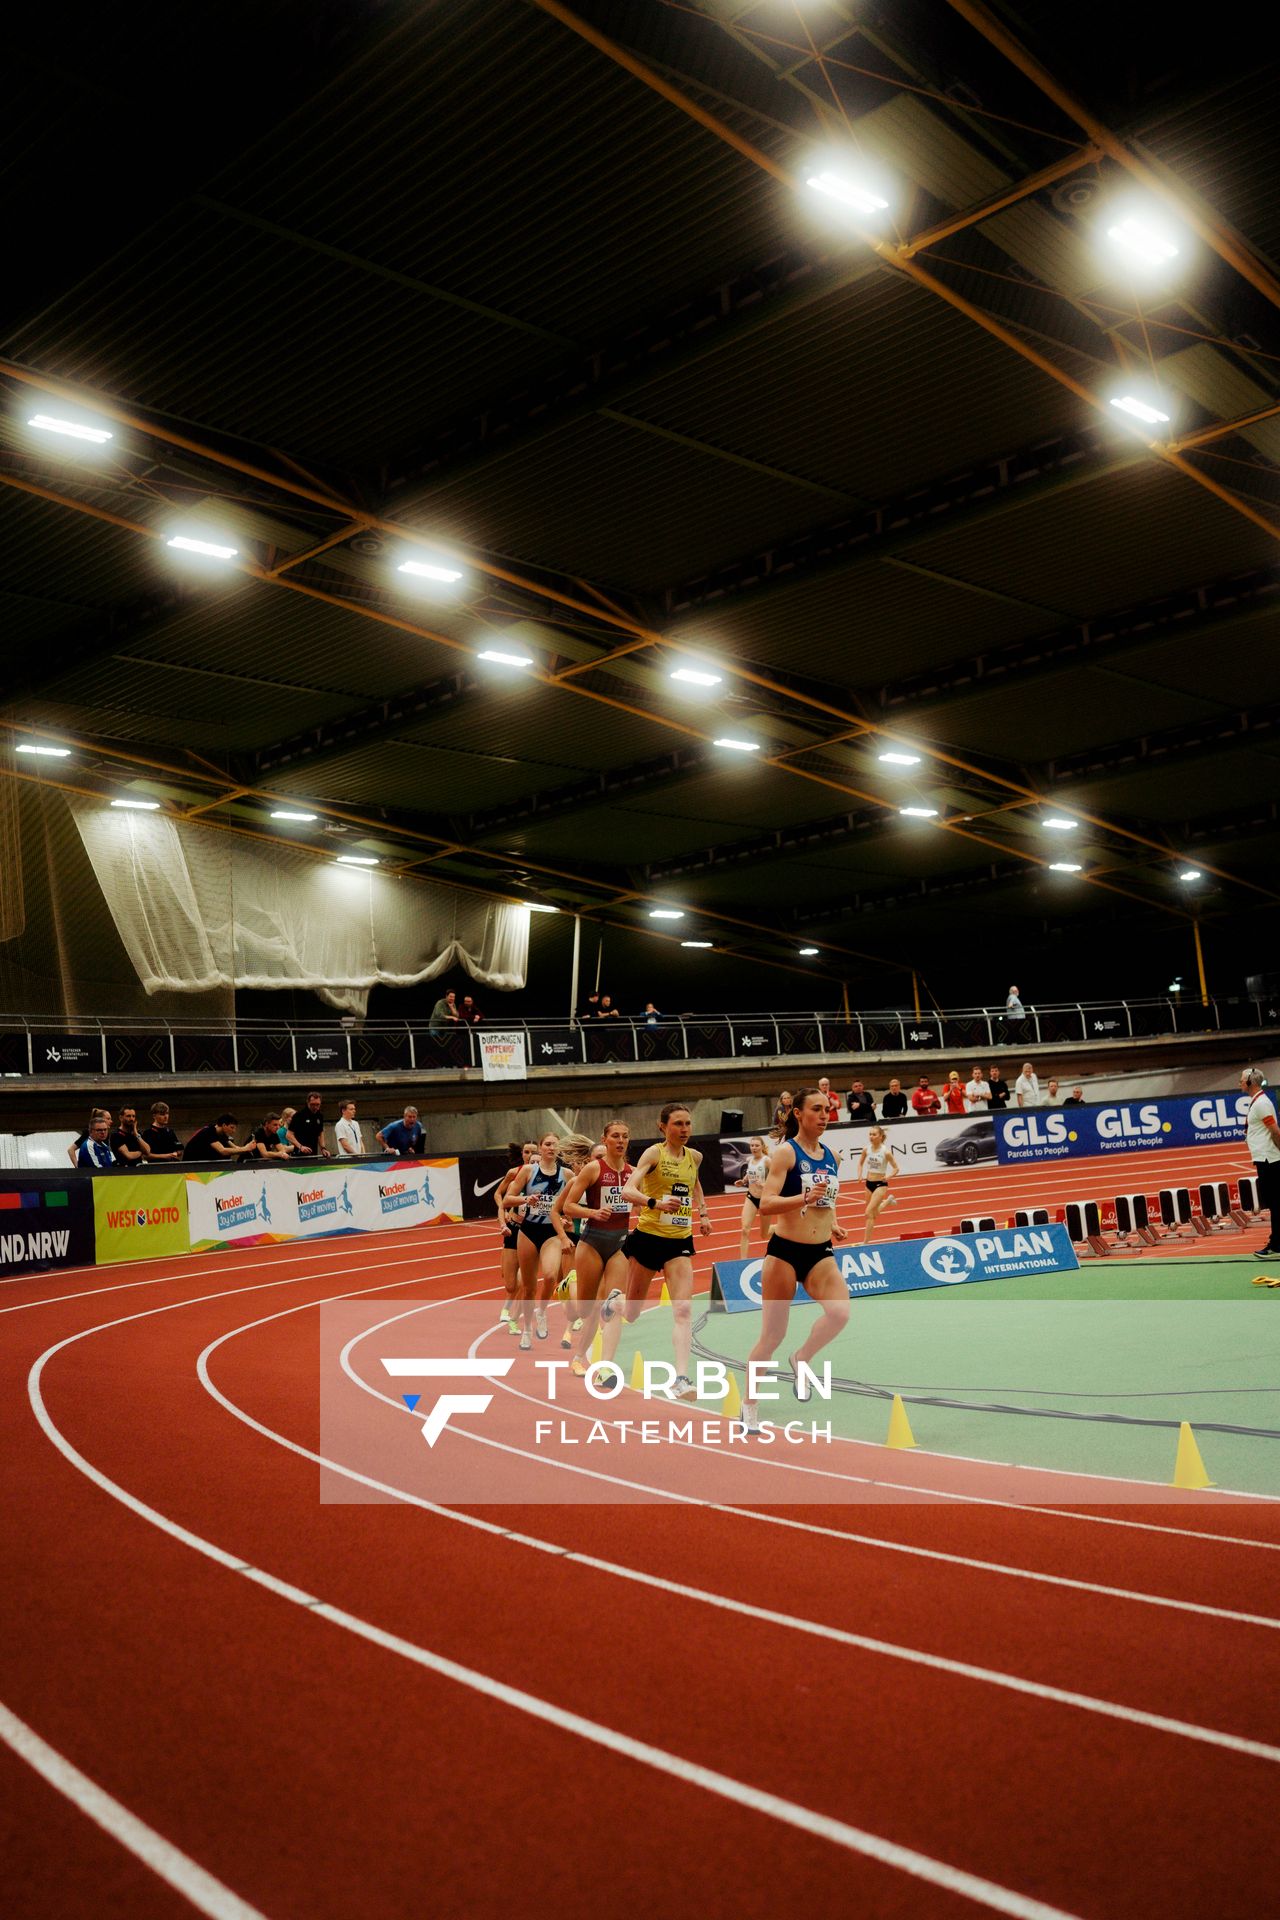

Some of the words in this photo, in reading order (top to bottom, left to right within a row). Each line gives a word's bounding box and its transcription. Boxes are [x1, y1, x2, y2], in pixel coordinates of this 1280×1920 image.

[1195, 1131, 1222, 1140] Parcels
[1223, 1130, 1231, 1138] to
[1100, 1139, 1128, 1150] Parcels
[1128, 1138, 1136, 1147] to
[1137, 1136, 1163, 1147] People
[1007, 1147, 1034, 1158] Parcels
[1035, 1147, 1043, 1156] to
[1044, 1145, 1069, 1157] People
[674, 1185, 689, 1194] HOKA
[975, 1230, 1054, 1261] PLAN
[842, 1251, 885, 1278] AN
[984, 1258, 1059, 1274] INTERNATIONAL
